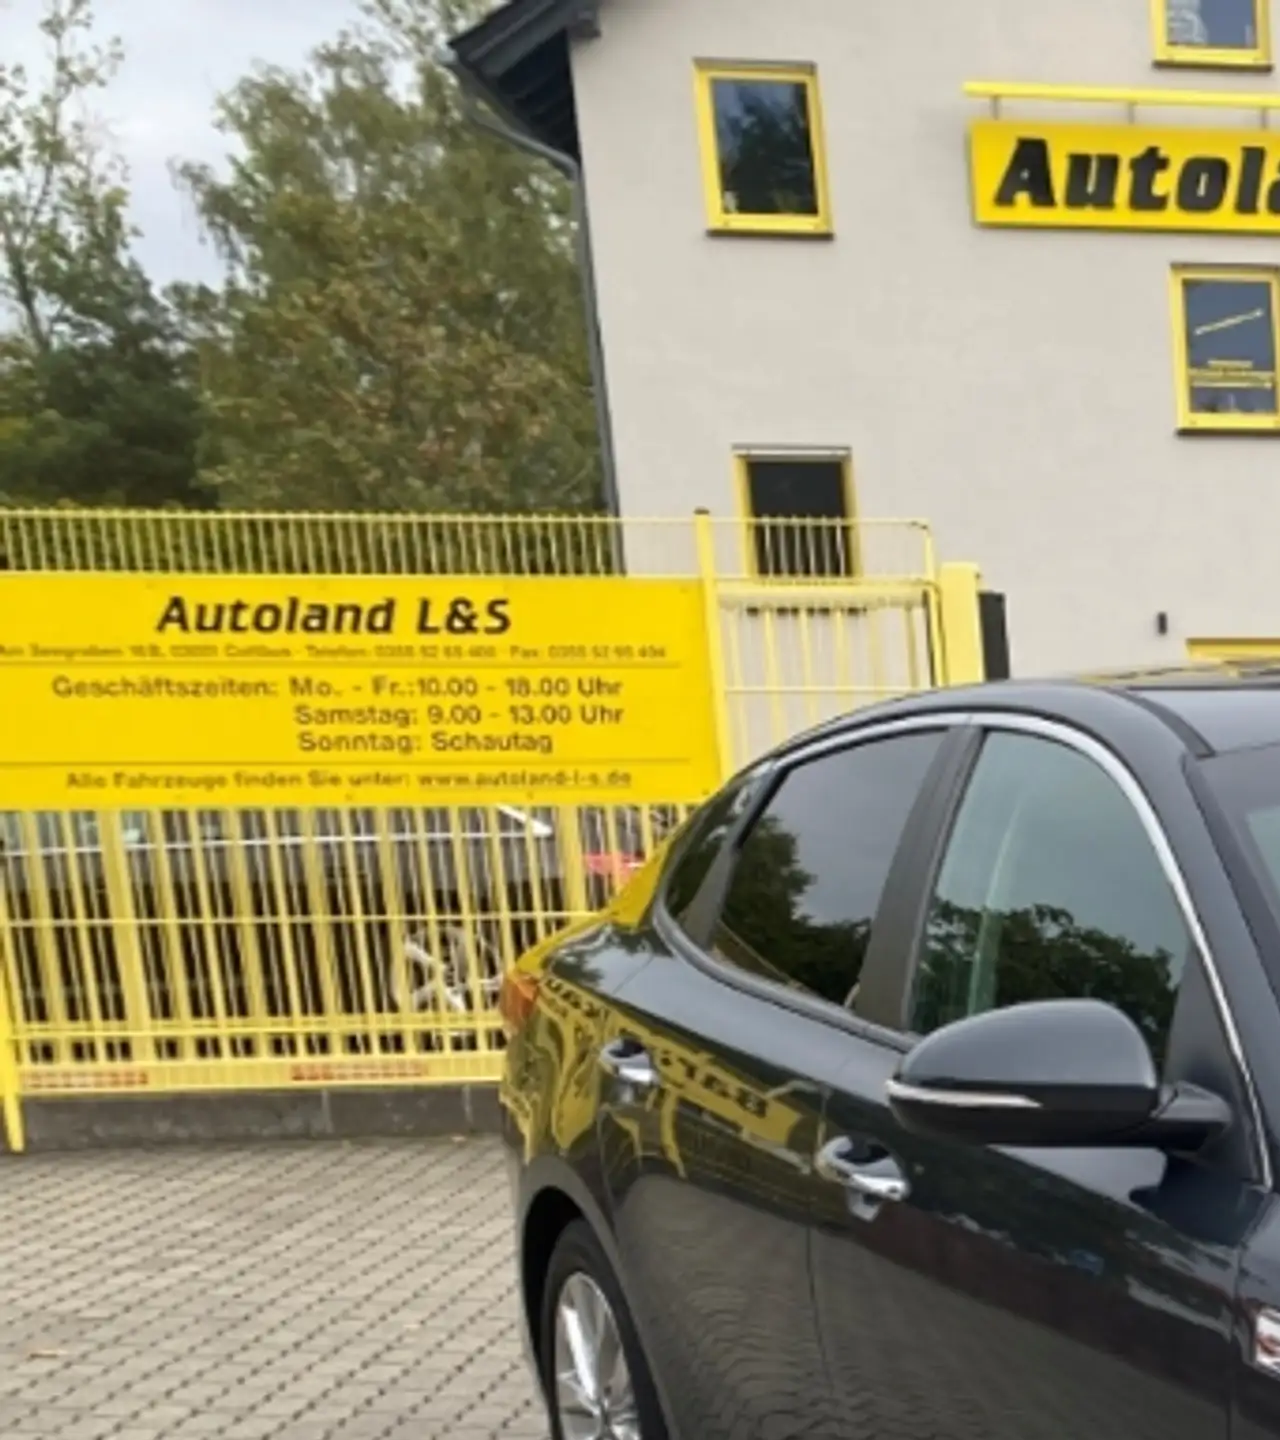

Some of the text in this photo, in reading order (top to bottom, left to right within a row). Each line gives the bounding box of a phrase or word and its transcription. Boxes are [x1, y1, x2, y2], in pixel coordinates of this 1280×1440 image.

[156, 596, 512, 635] Autoland L&S
[52, 675, 279, 698] Geschäftszeiten:
[289, 676, 343, 698] Mo.
[577, 676, 623, 698] Uhr
[294, 703, 418, 727] Samstag:
[580, 704, 624, 725] Uhr
[298, 731, 553, 755] Sonntag: Schautag
[66, 772, 106, 789] Alle
[113, 771, 227, 792] Fahrzeuge
[234, 772, 302, 789] finden
[308, 770, 342, 787] Sie
